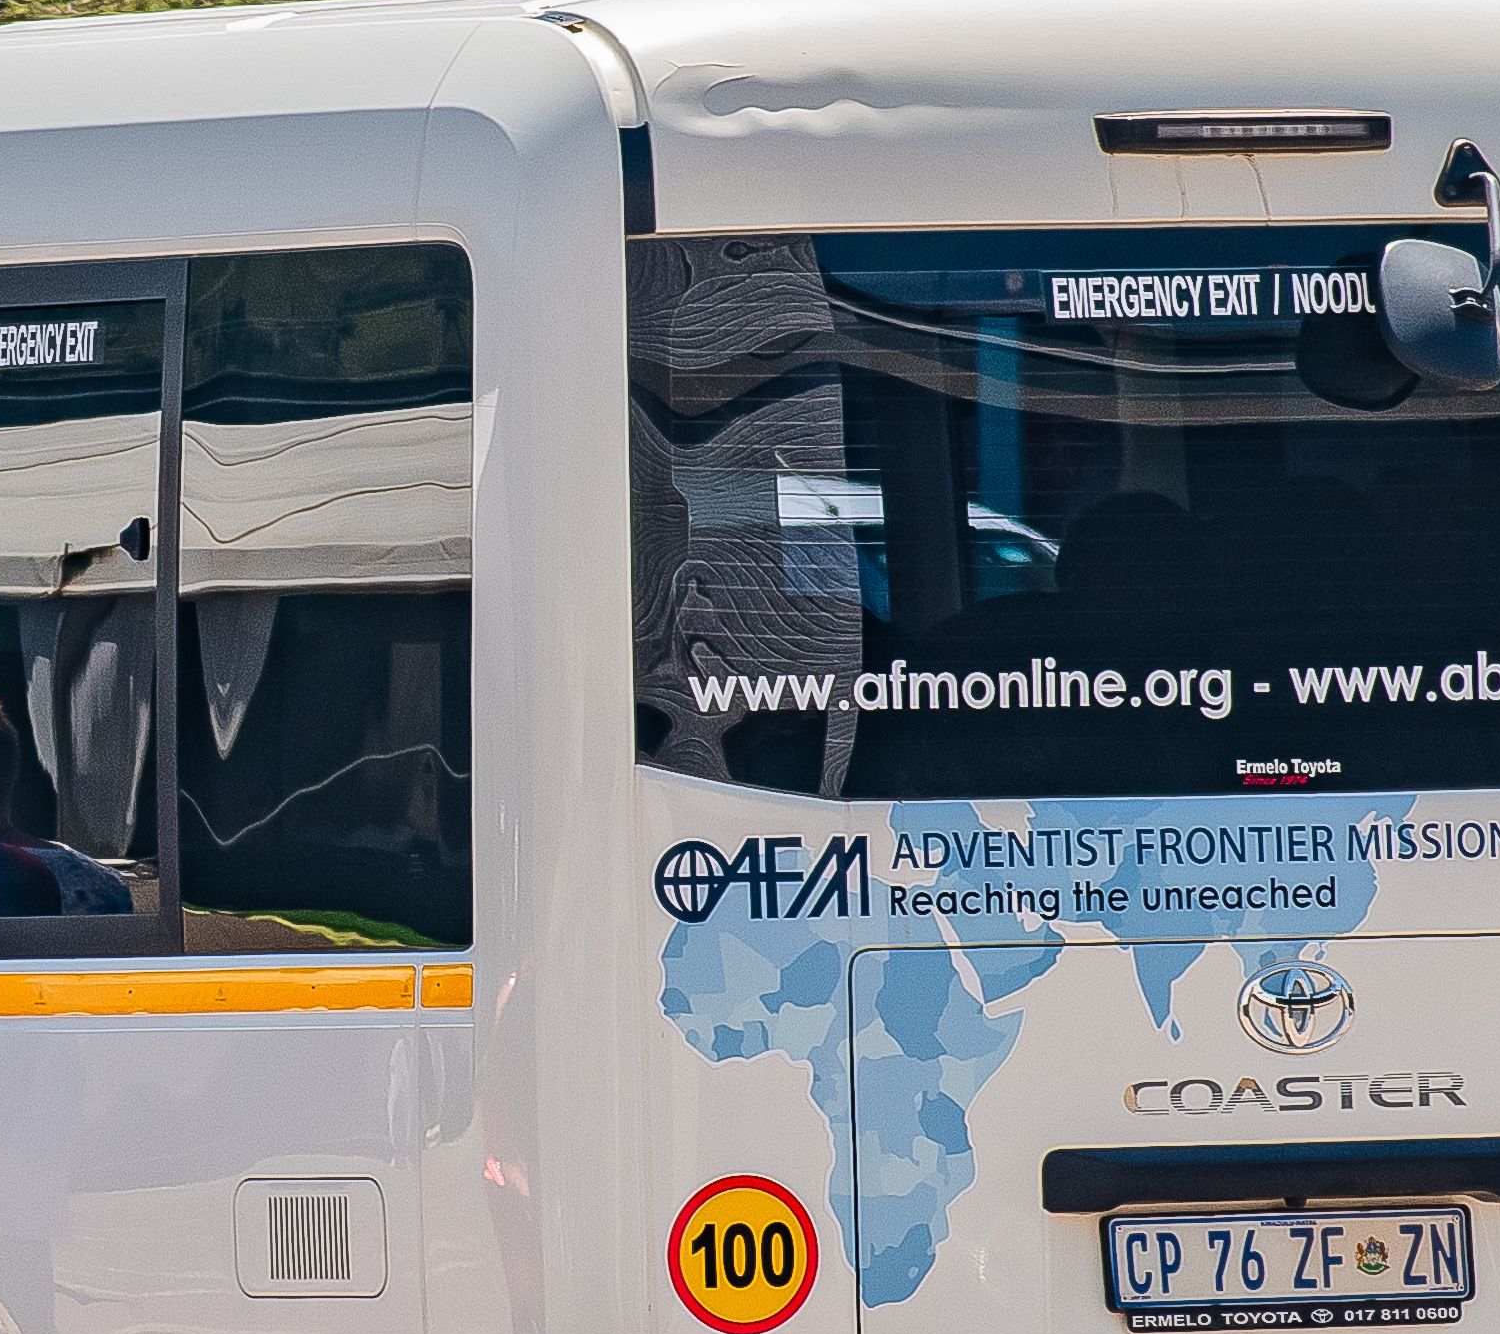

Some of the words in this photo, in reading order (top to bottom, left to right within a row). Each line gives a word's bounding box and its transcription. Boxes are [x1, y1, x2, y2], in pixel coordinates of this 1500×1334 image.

[1052, 275, 1202, 318] EMERGENCY
[1208, 274, 1260, 315] EXIT
[65, 321, 98, 363] EXIT
[688, 656, 1232, 720] www.afmonline.org
[1236, 759, 1289, 775] Ermelo
[1291, 758, 1342, 777] Toyota
[892, 828, 1122, 869] ADVENTIST
[1136, 825, 1335, 865] FRONTIER
[890, 881, 1060, 920] Reaching
[1074, 881, 1129, 913] the
[1142, 875, 1337, 912] unreached
[1123, 1072, 1467, 1115] COASTER
[692, 1222, 794, 1288] 100
[1125, 1231, 1182, 1295] CP
[1208, 1229, 1265, 1292] 76
[1288, 1226, 1345, 1289] ZF
[1399, 1222, 1460, 1286] ZN
[1131, 1314, 1212, 1328] ERMELO
[1221, 1311, 1303, 1326] TOYOTA
[1344, 1308, 1375, 1322] 017
[1380, 1307, 1411, 1321] 811
[1416, 1306, 1460, 1320] 0600
